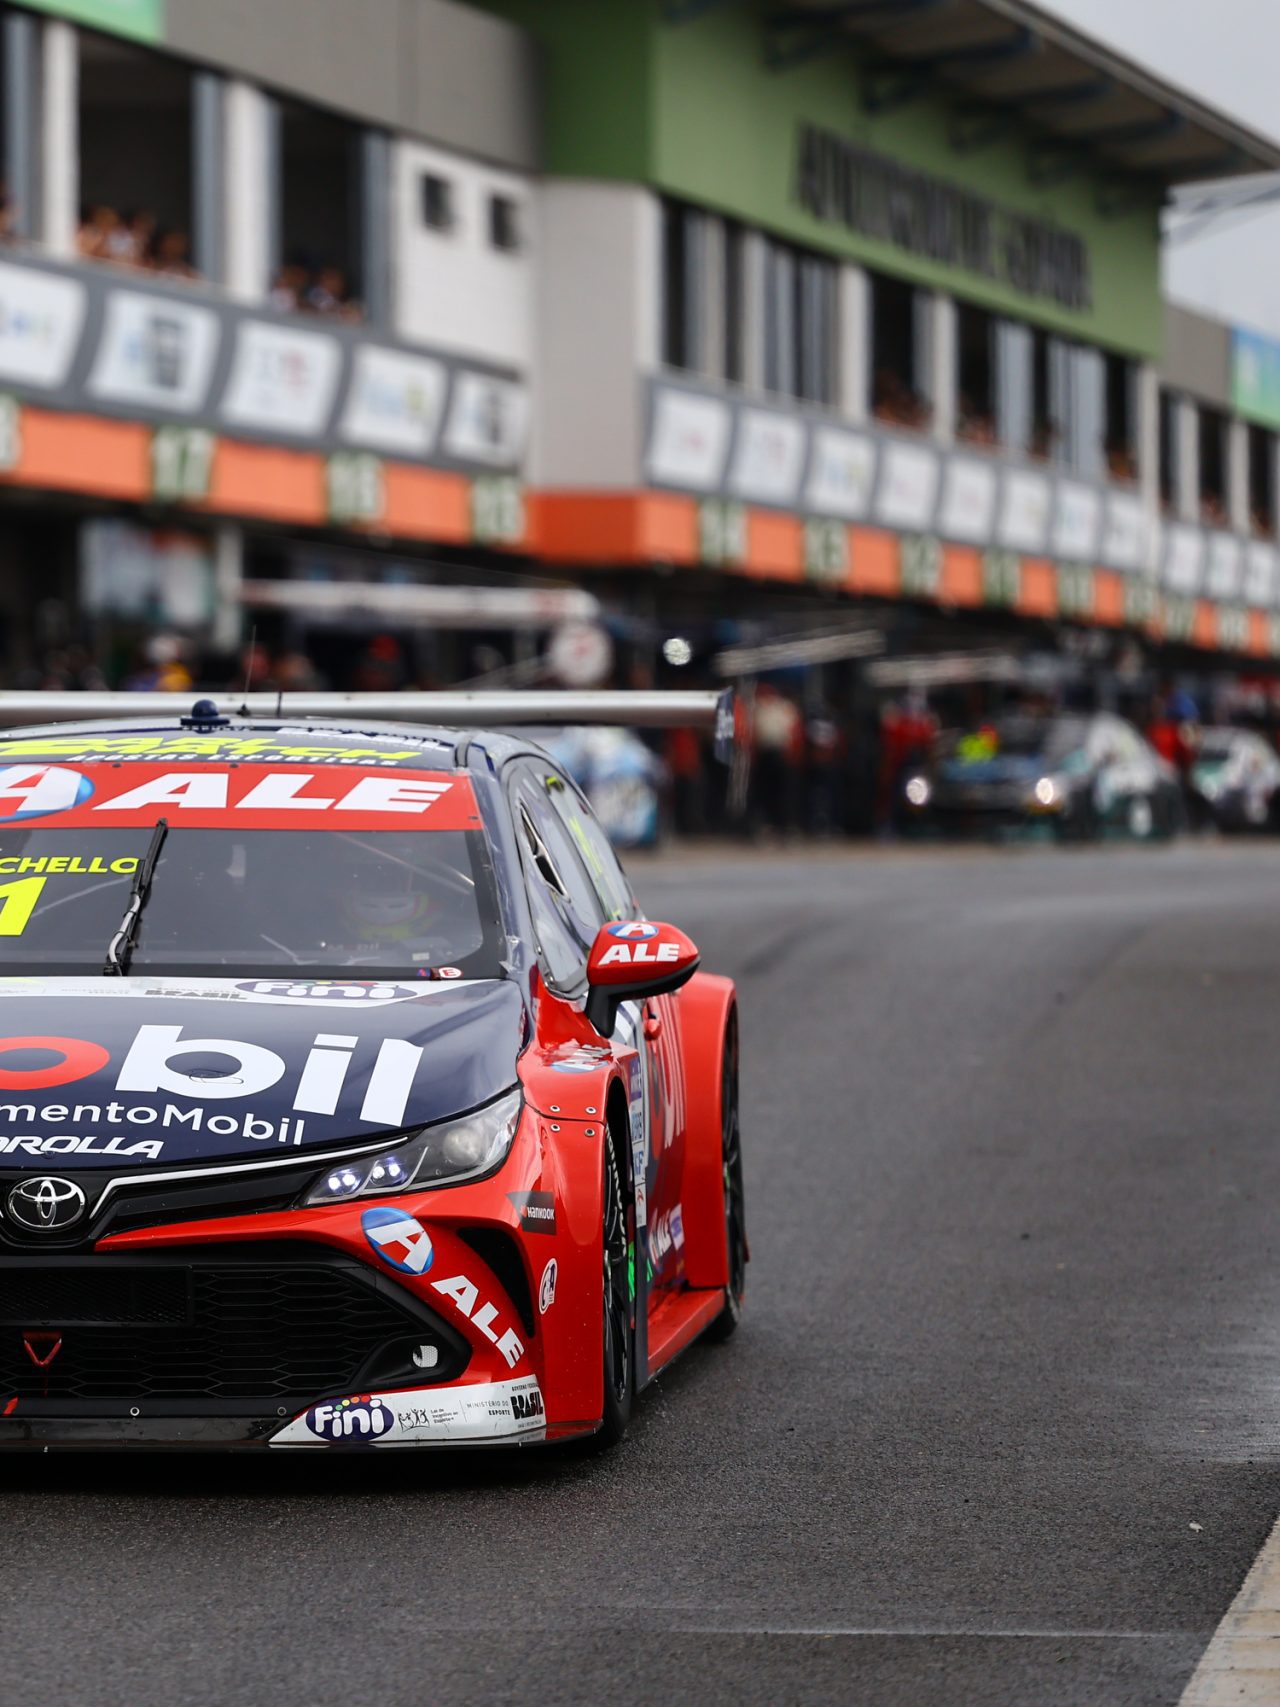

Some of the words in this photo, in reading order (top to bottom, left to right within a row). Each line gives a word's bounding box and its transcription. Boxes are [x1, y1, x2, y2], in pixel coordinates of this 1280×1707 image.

[66, 754, 198, 762] APOSTAS
[207, 754, 400, 766] ESPORTIVAS
[92, 773, 454, 813] ALE
[598, 943, 680, 966] ALE
[253, 981, 400, 998] Fini
[430, 1275, 524, 1369] ALE
[315, 1399, 386, 1437] Fini
[510, 1391, 543, 1420] BRASIL
